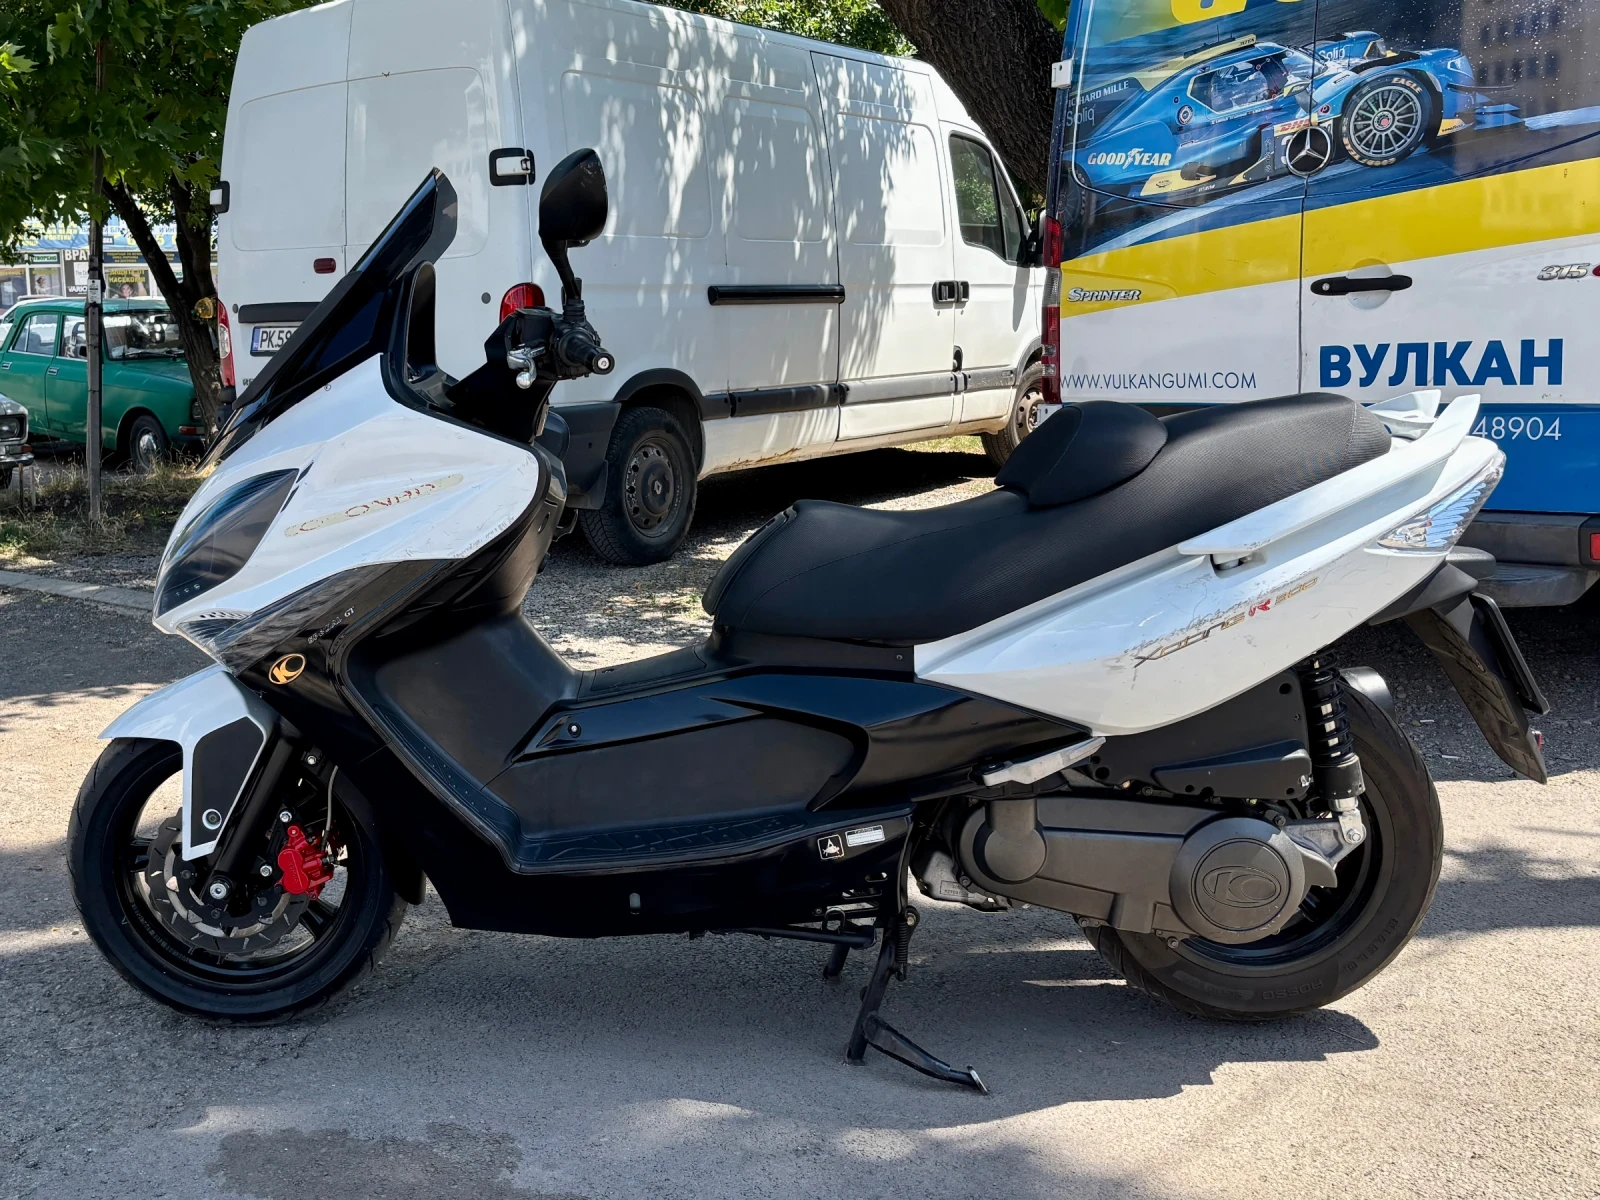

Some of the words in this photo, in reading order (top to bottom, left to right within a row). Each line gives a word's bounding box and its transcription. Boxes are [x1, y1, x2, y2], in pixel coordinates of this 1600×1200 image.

[1068, 92, 1102, 108] ICHARD
[1103, 80, 1130, 97] MILLE
[1391, 77, 1423, 94] EAGLE
[1088, 149, 1172, 168] GOODYEAR
[1537, 263, 1591, 281] 315
[1068, 287, 1142, 302] SPRINTER
[1319, 338, 1564, 388] ВУЛКАН
[1060, 371, 1257, 390] WWW.VULKANGUMI.COM
[344, 606, 355, 618] GT
[1262, 978, 1324, 1000] ROSSO
